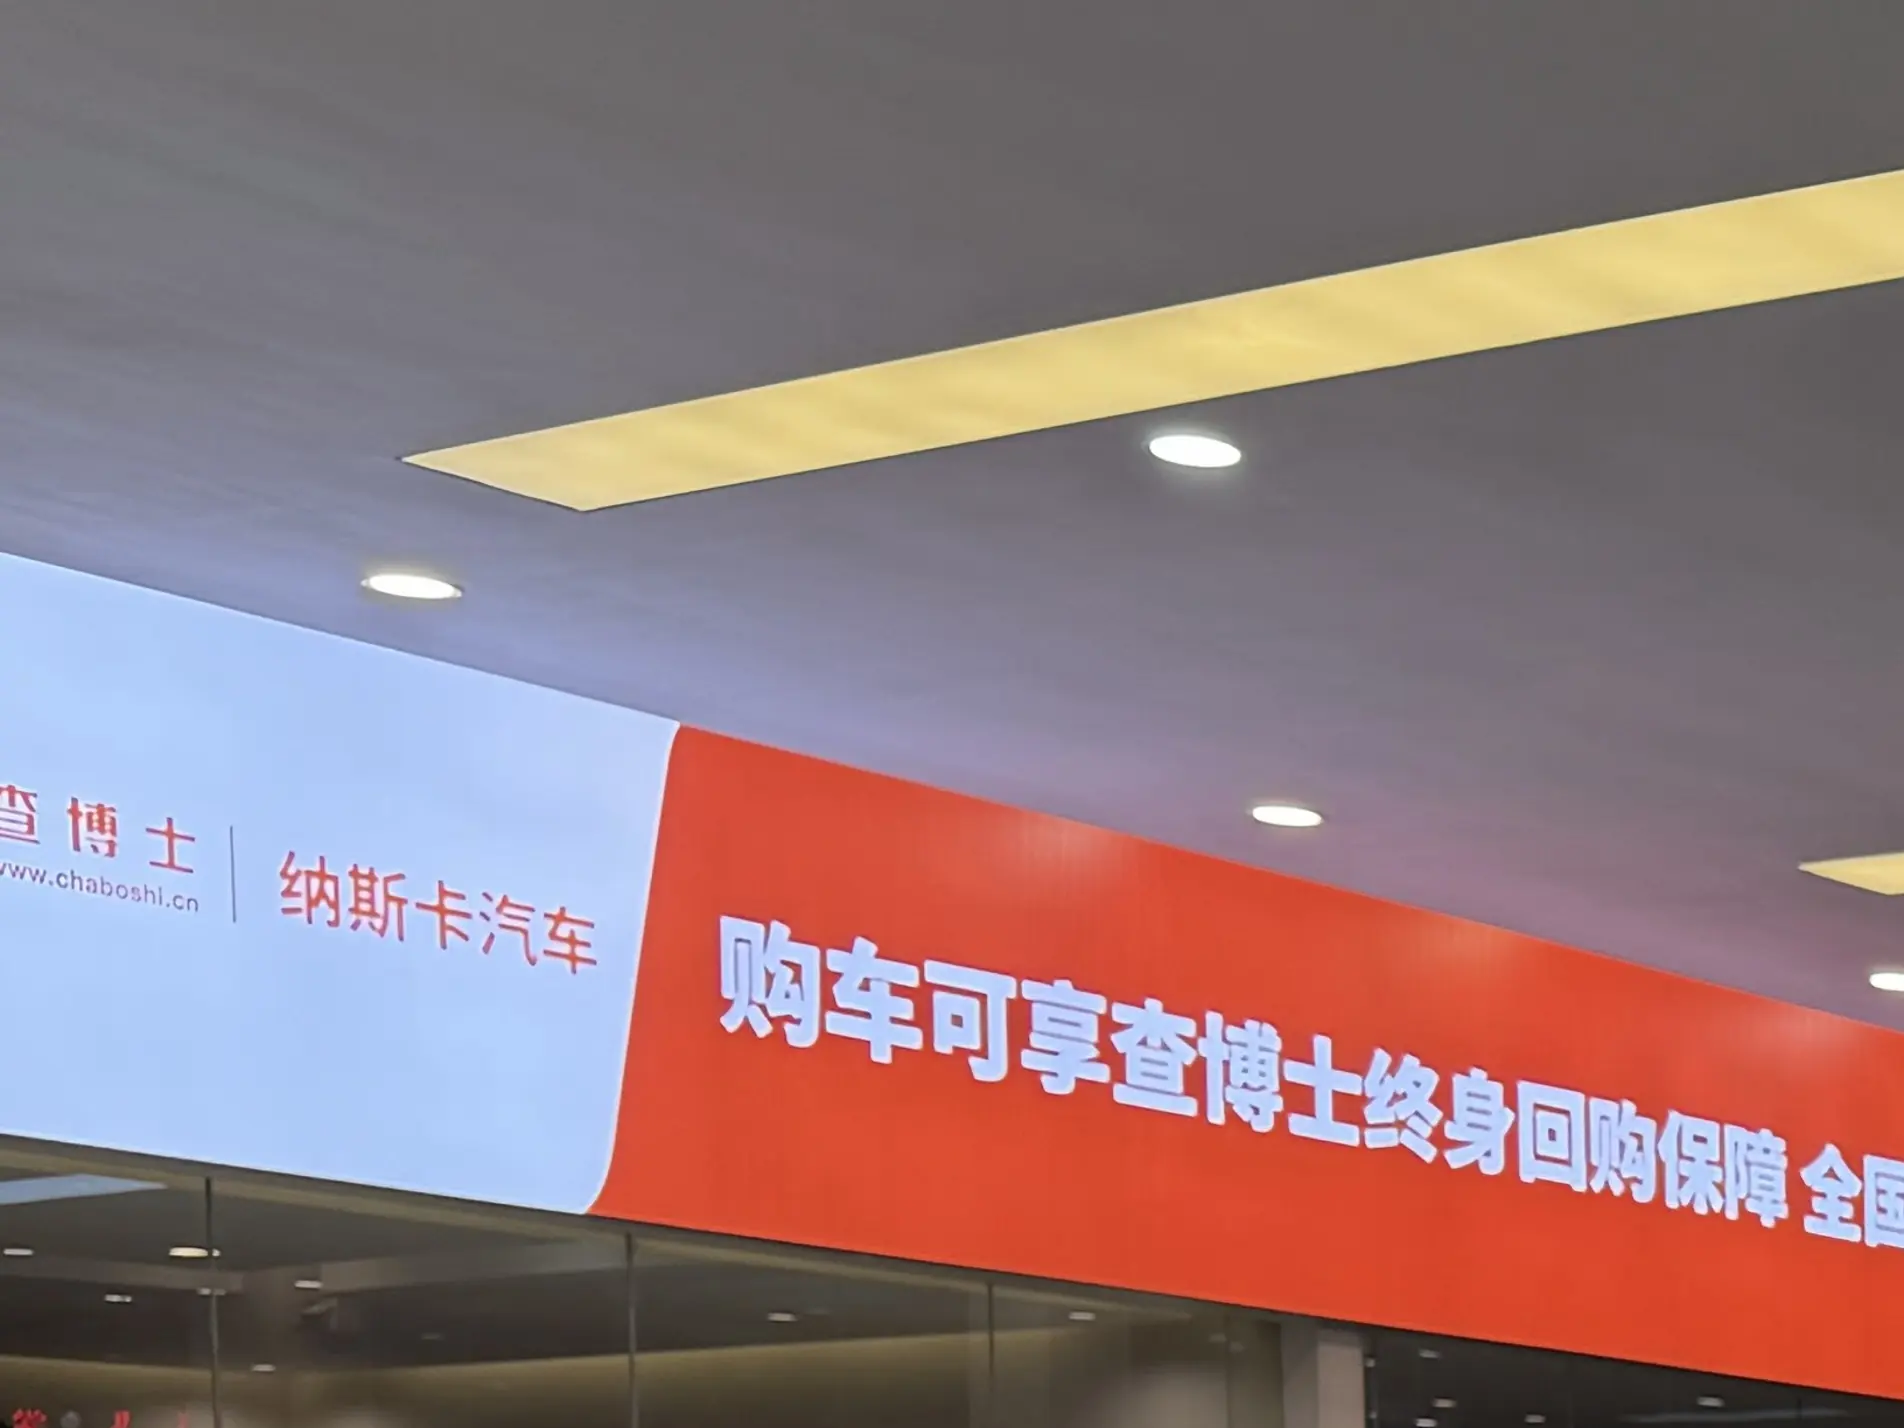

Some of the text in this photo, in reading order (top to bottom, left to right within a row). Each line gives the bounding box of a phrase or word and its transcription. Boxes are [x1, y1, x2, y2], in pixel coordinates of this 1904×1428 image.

[0, 784, 196, 874] 查博士
[279, 851, 597, 974] 纳斯卡汽车
[719, 915, 1788, 1228] 购车可享查博士终身回购保障
